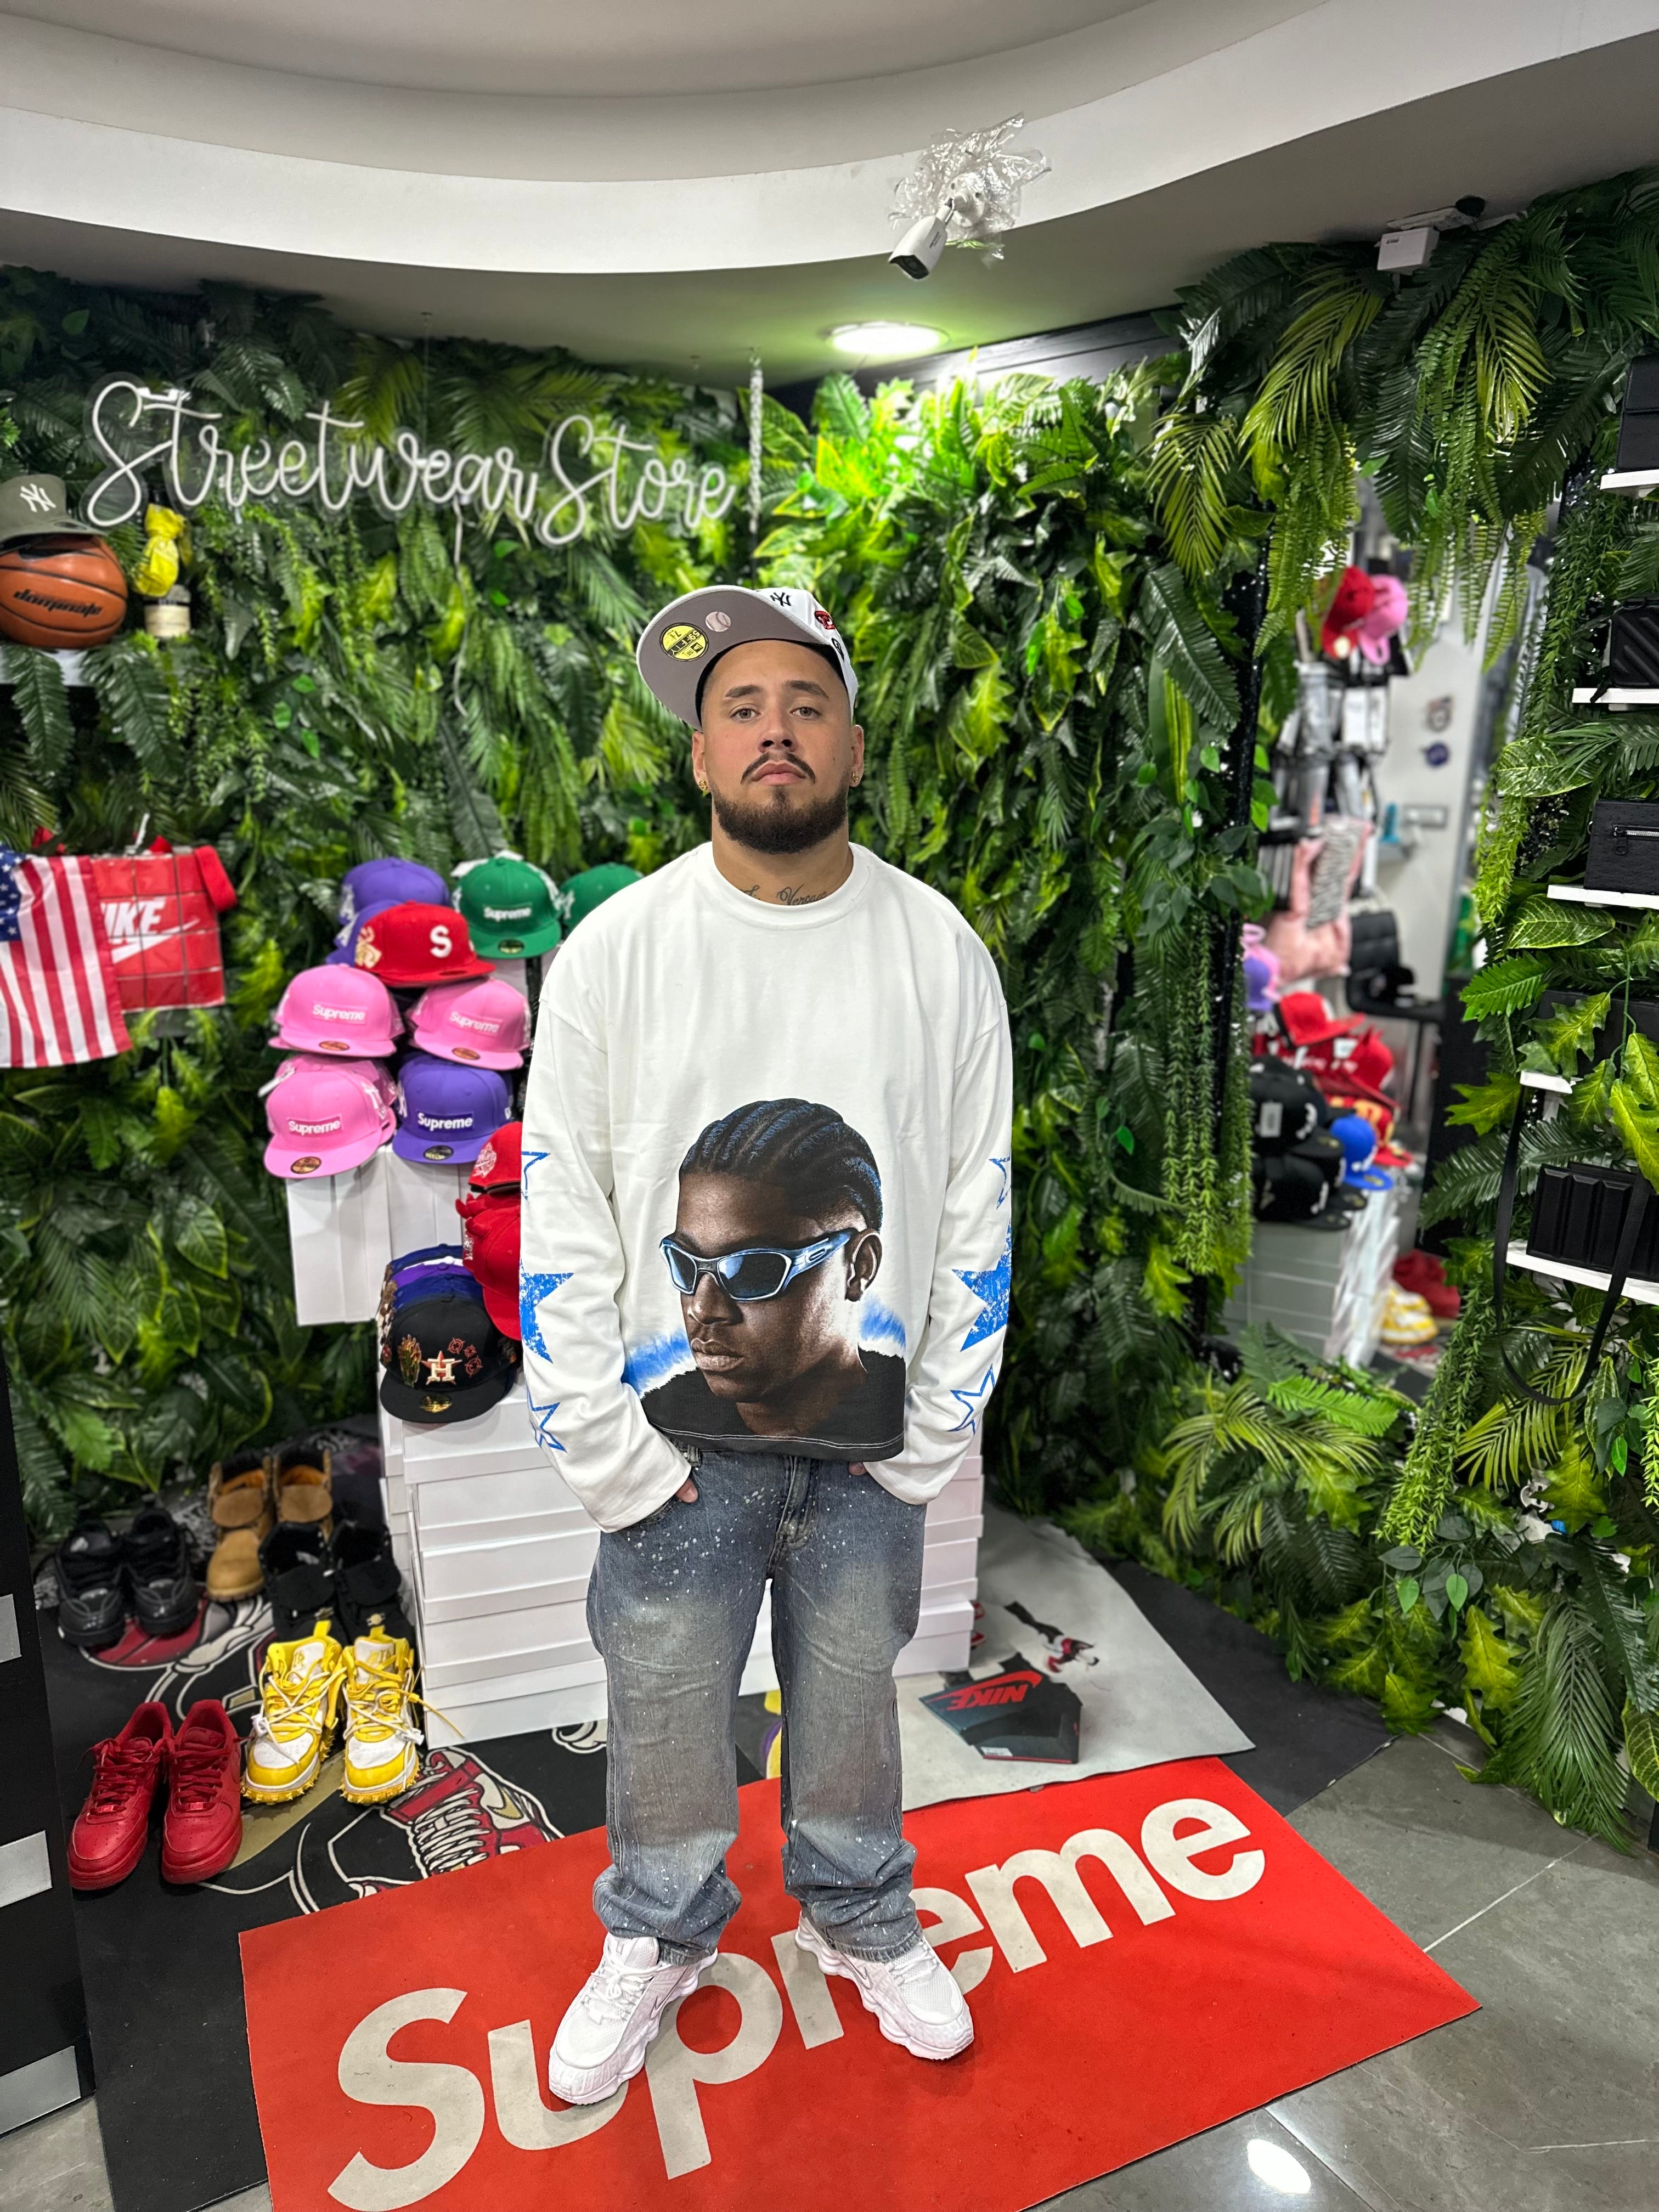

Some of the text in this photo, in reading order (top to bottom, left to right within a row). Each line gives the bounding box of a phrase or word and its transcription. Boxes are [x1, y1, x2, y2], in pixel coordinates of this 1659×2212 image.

[87, 380, 736, 546] Streetwear Store
[100, 896, 166, 945] IKE
[483, 906, 532, 922] Supreme
[430, 924, 453, 958] S
[312, 1003, 365, 1020] Supreme
[449, 1011, 499, 1033] Supreme
[288, 1120, 341, 1136] Supreme
[417, 1111, 473, 1132] Supreme
[946, 1684, 1029, 1711] NIKE
